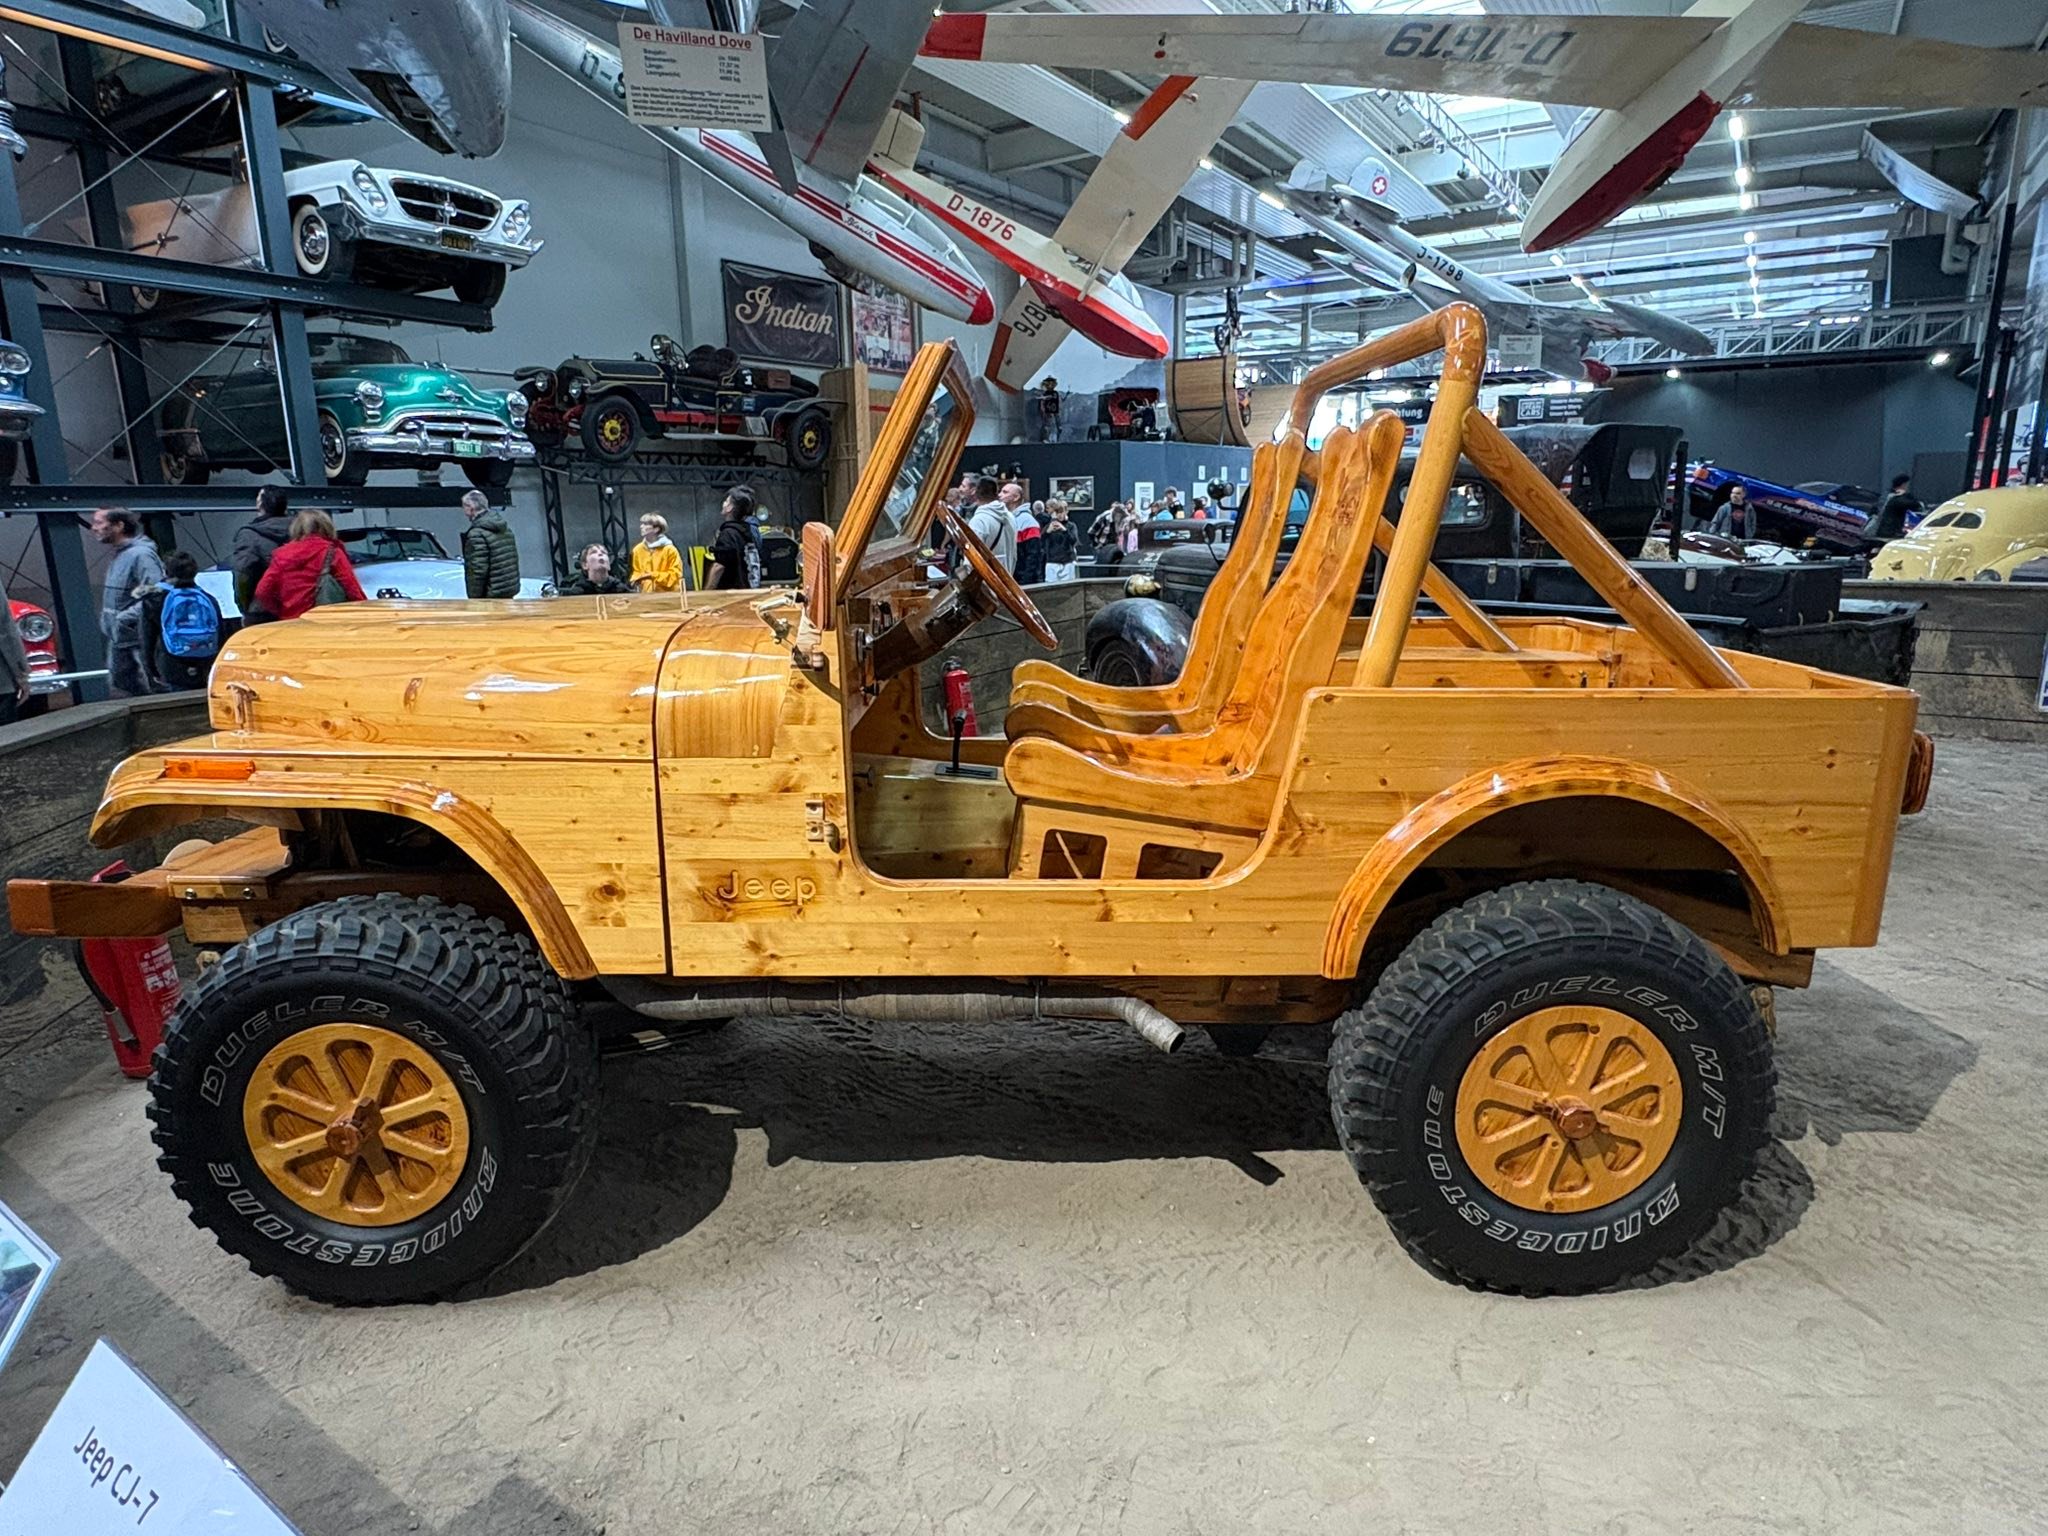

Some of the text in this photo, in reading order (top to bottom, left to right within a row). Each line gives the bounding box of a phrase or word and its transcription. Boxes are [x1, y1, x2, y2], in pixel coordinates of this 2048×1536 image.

[633, 26, 752, 49] De Havilland Dove
[1385, 22, 1577, 65] D-1619
[580, 50, 626, 99] D-8
[947, 194, 1016, 241] D-1876
[1416, 246, 1464, 281] J-1798
[735, 285, 833, 336] Indian
[1396, 408, 1423, 419] htung
[717, 869, 817, 906] Jeep
[200, 995, 486, 1106] DUELER M/T
[1474, 975, 1727, 1139] DUELER M/T
[1424, 1085, 1680, 1254] BRIDGESTONE
[208, 1146, 498, 1266] BRIDGESTONE
[73, 1425, 160, 1526] Jeep CJ-7
